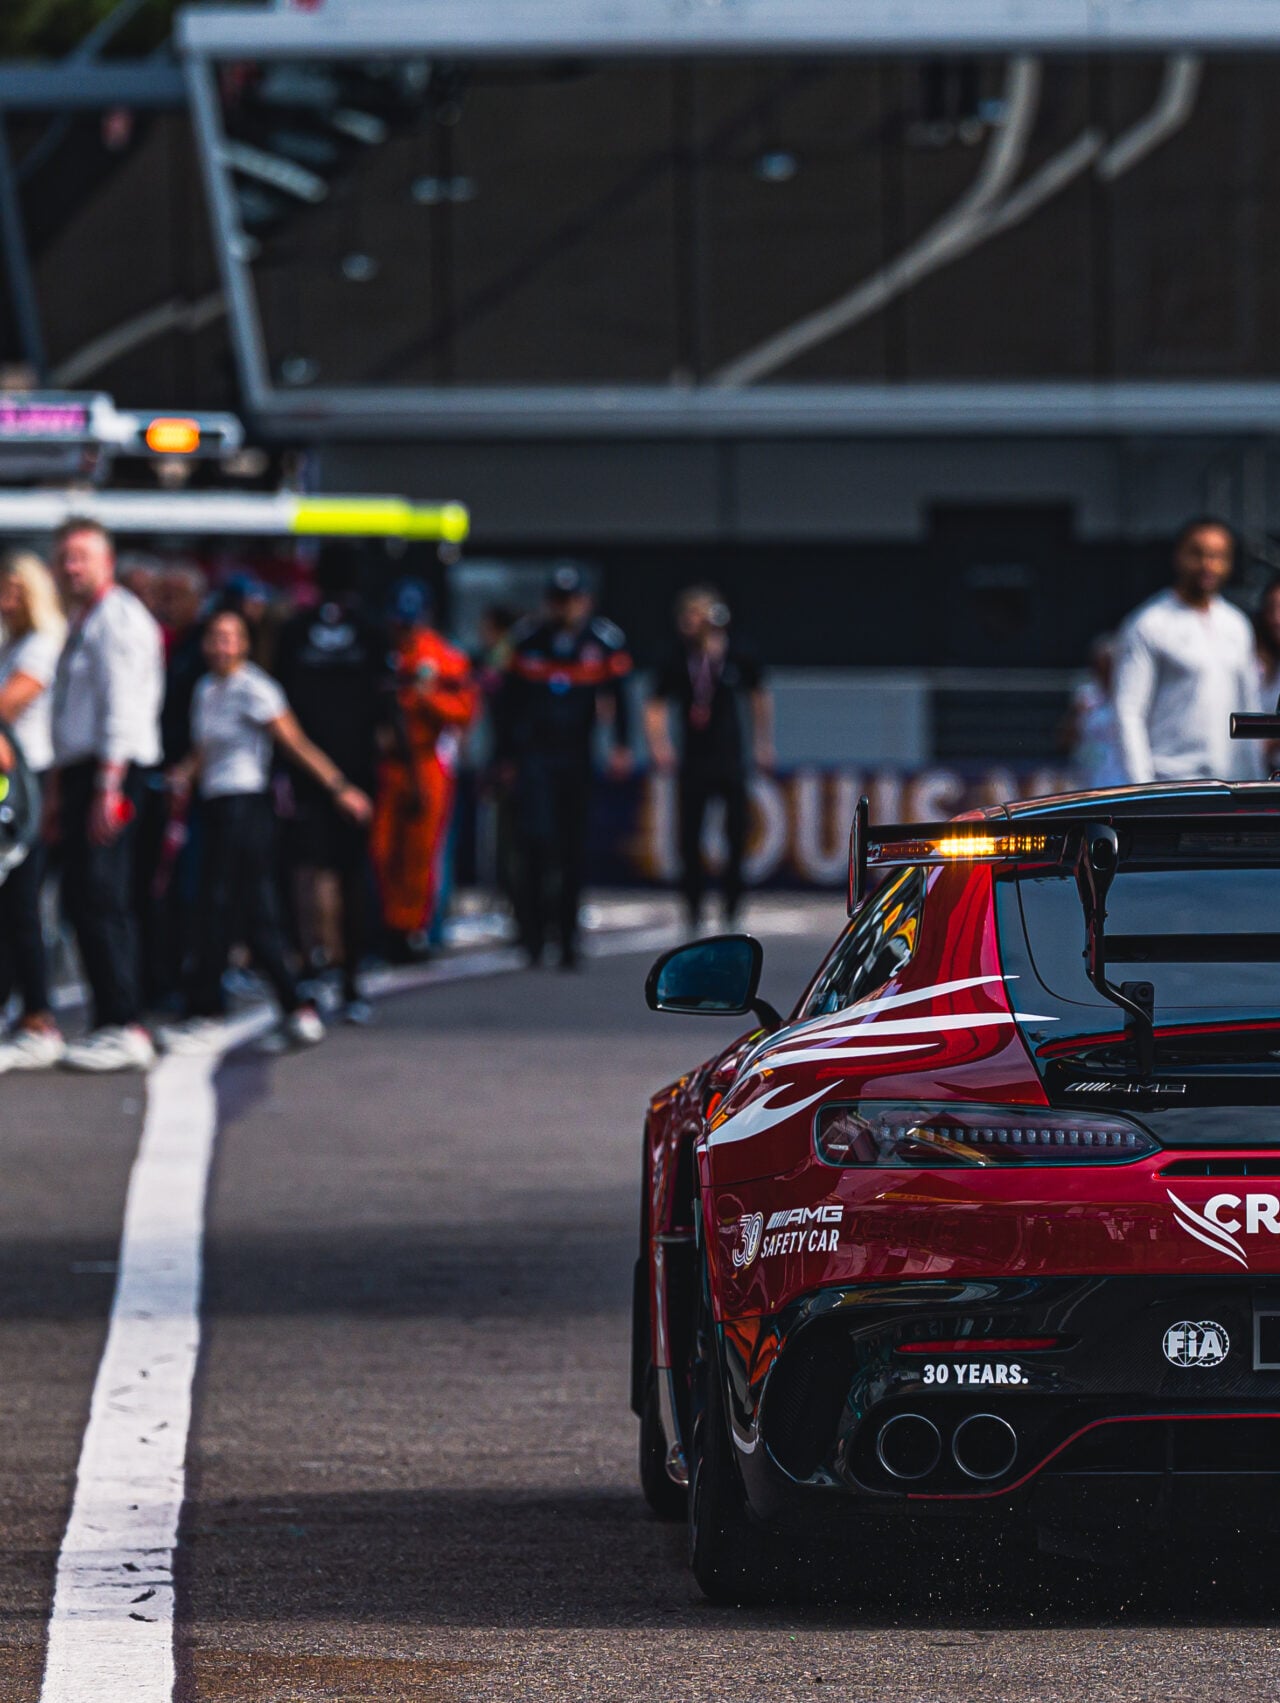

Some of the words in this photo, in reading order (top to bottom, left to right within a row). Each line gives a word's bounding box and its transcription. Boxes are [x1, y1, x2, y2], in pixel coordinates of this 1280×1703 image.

[785, 1205, 844, 1227] AMG
[760, 1230, 808, 1259] SAFETY
[808, 1228, 840, 1252] CAR
[922, 1363, 949, 1385] 30
[952, 1363, 1029, 1385] YEARS.
